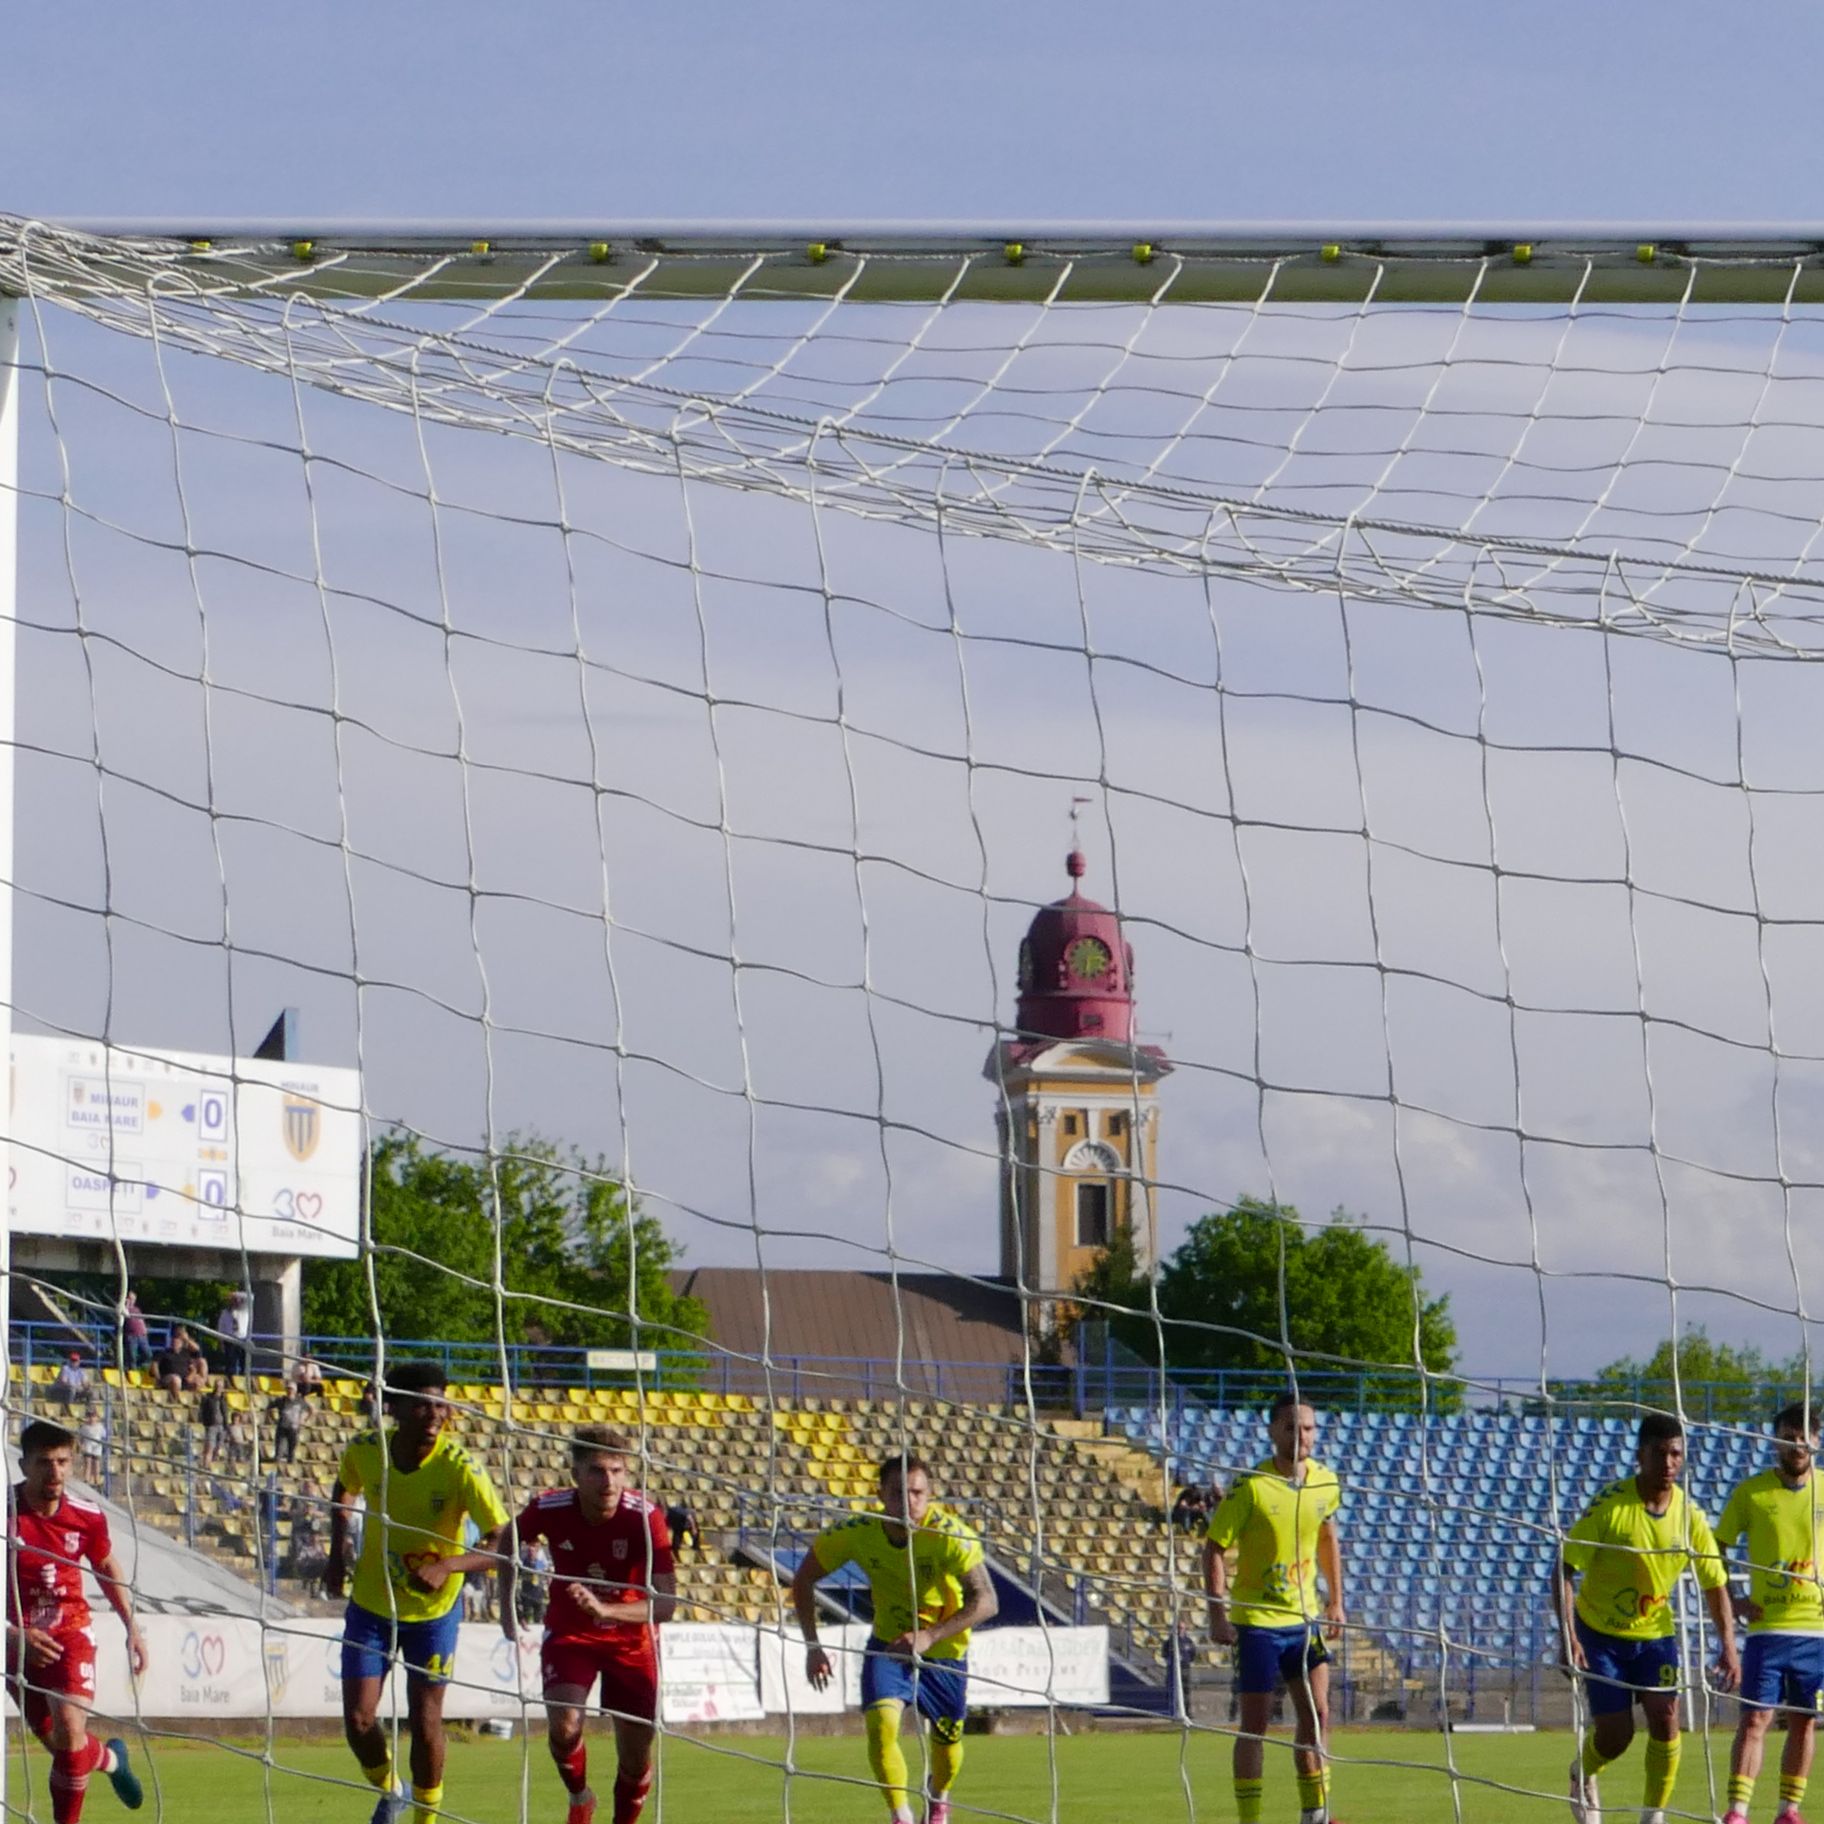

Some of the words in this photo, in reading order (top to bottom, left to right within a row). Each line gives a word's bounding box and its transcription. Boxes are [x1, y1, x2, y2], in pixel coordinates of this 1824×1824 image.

[71, 1110, 101, 1124] BAIA
[204, 1098, 223, 1128] 0
[180, 1684, 200, 1703] Baia
[203, 1685, 231, 1704] Mare
